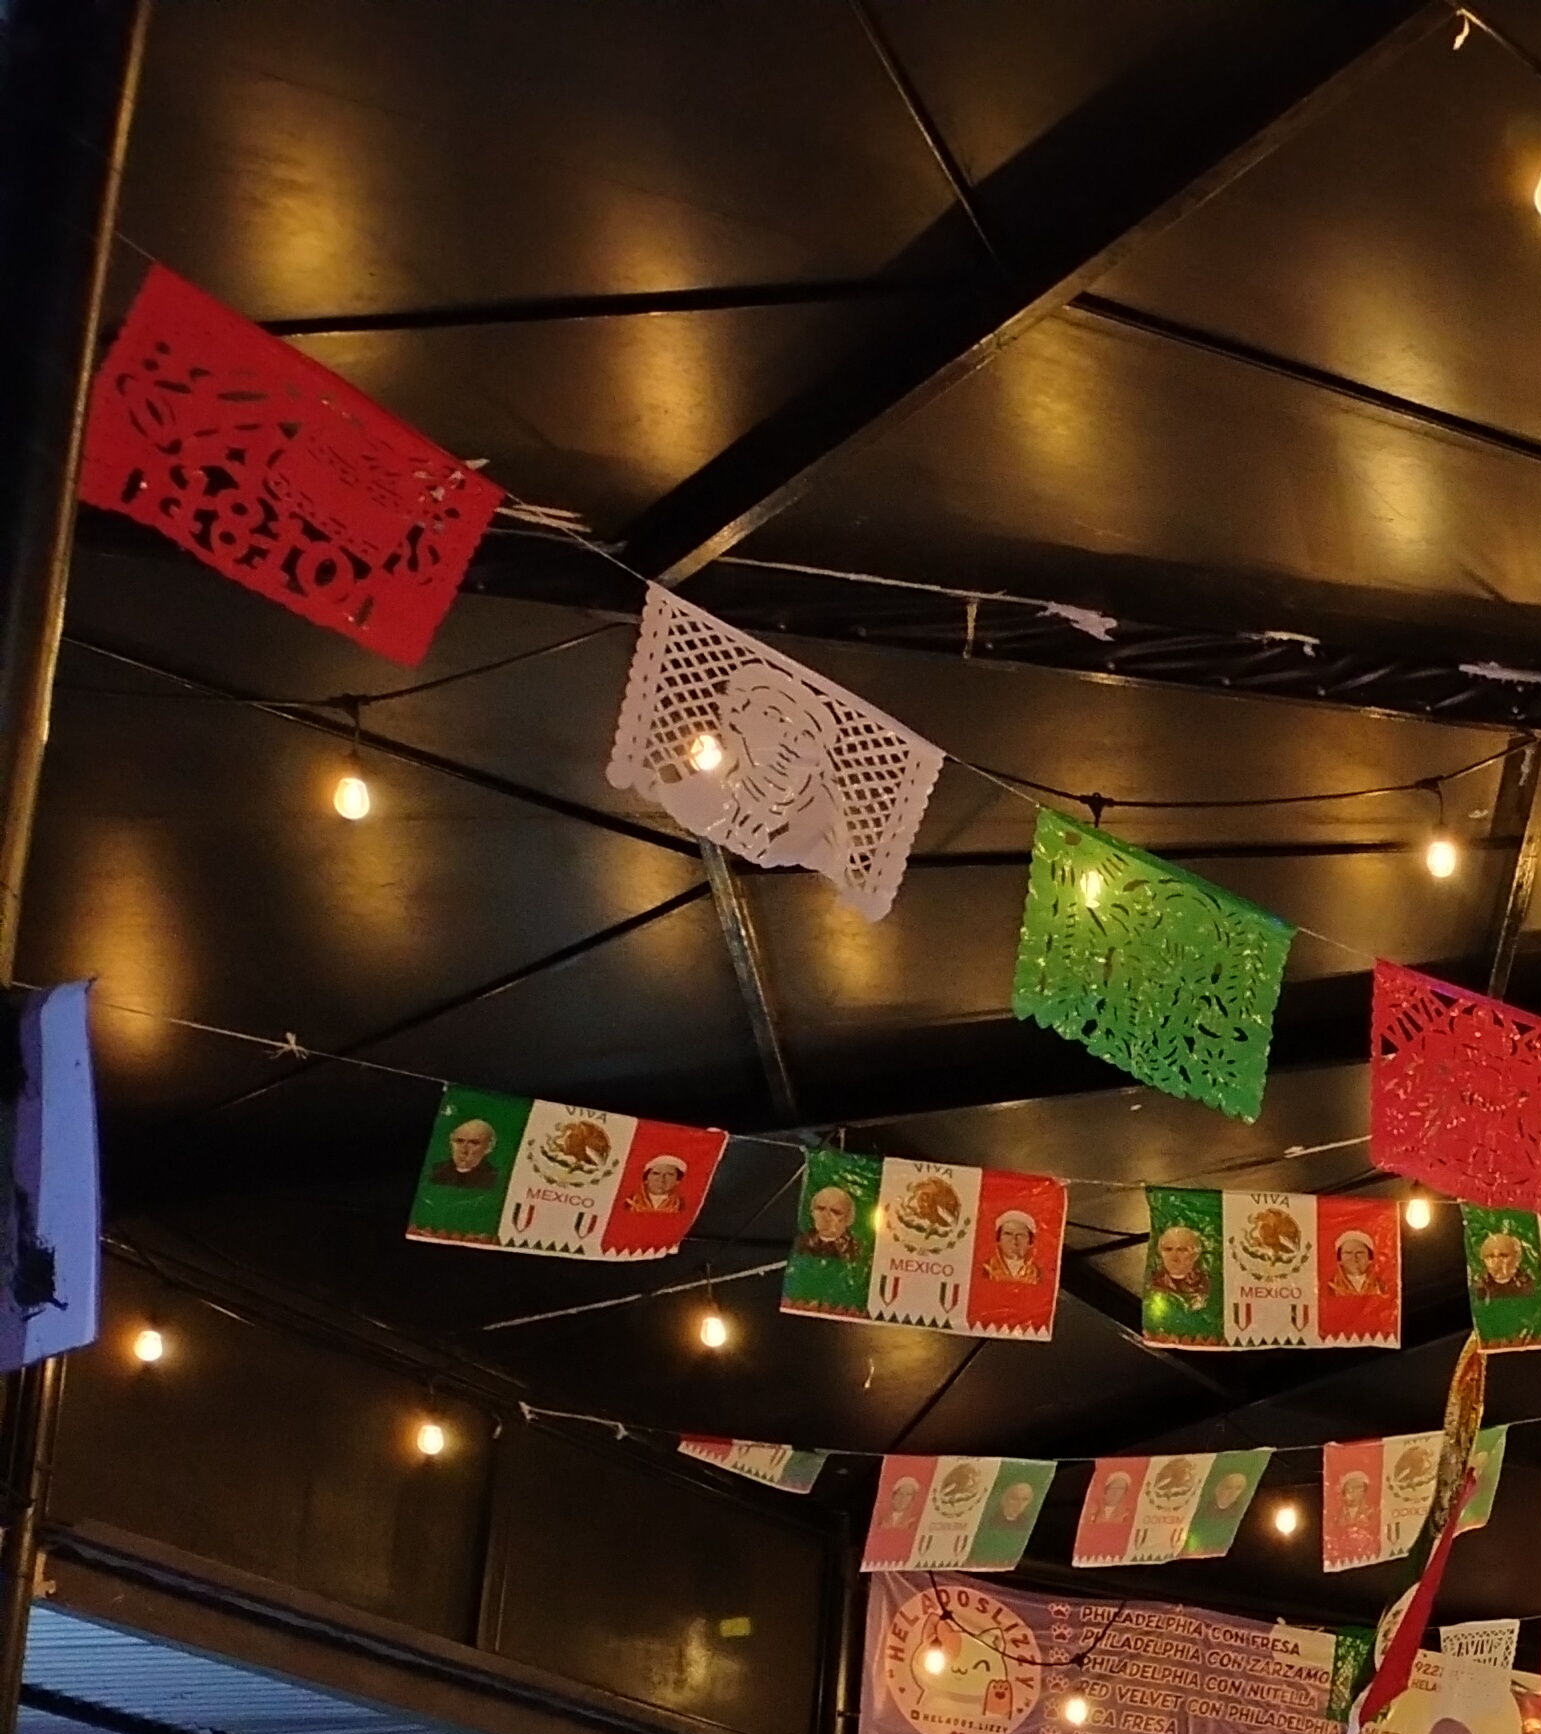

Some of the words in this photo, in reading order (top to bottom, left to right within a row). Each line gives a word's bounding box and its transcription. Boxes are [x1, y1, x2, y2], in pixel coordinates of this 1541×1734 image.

[566, 1104, 609, 1125] VIVA
[526, 1187, 595, 1209] MEXICO
[1250, 1193, 1291, 1209] VIVA
[889, 1258, 955, 1277] MEXICO
[1239, 1285, 1303, 1301] MEXICO
[1081, 1606, 1203, 1637] PHILADELPHIA
[1211, 1626, 1246, 1644] CON
[1250, 1634, 1301, 1656] FRESA
[1080, 1628, 1202, 1661] PHILADELPHIA
[1207, 1650, 1244, 1670] CON
[1247, 1656, 1331, 1685] ZARZAMO
[1081, 1655, 1200, 1689] PHILADELPHIA
[1206, 1674, 1242, 1693] CON
[1247, 1681, 1319, 1710] NUTELLA
[1078, 1679, 1110, 1699] RED
[1117, 1686, 1182, 1710] VELVET
[1187, 1696, 1223, 1716] CON
